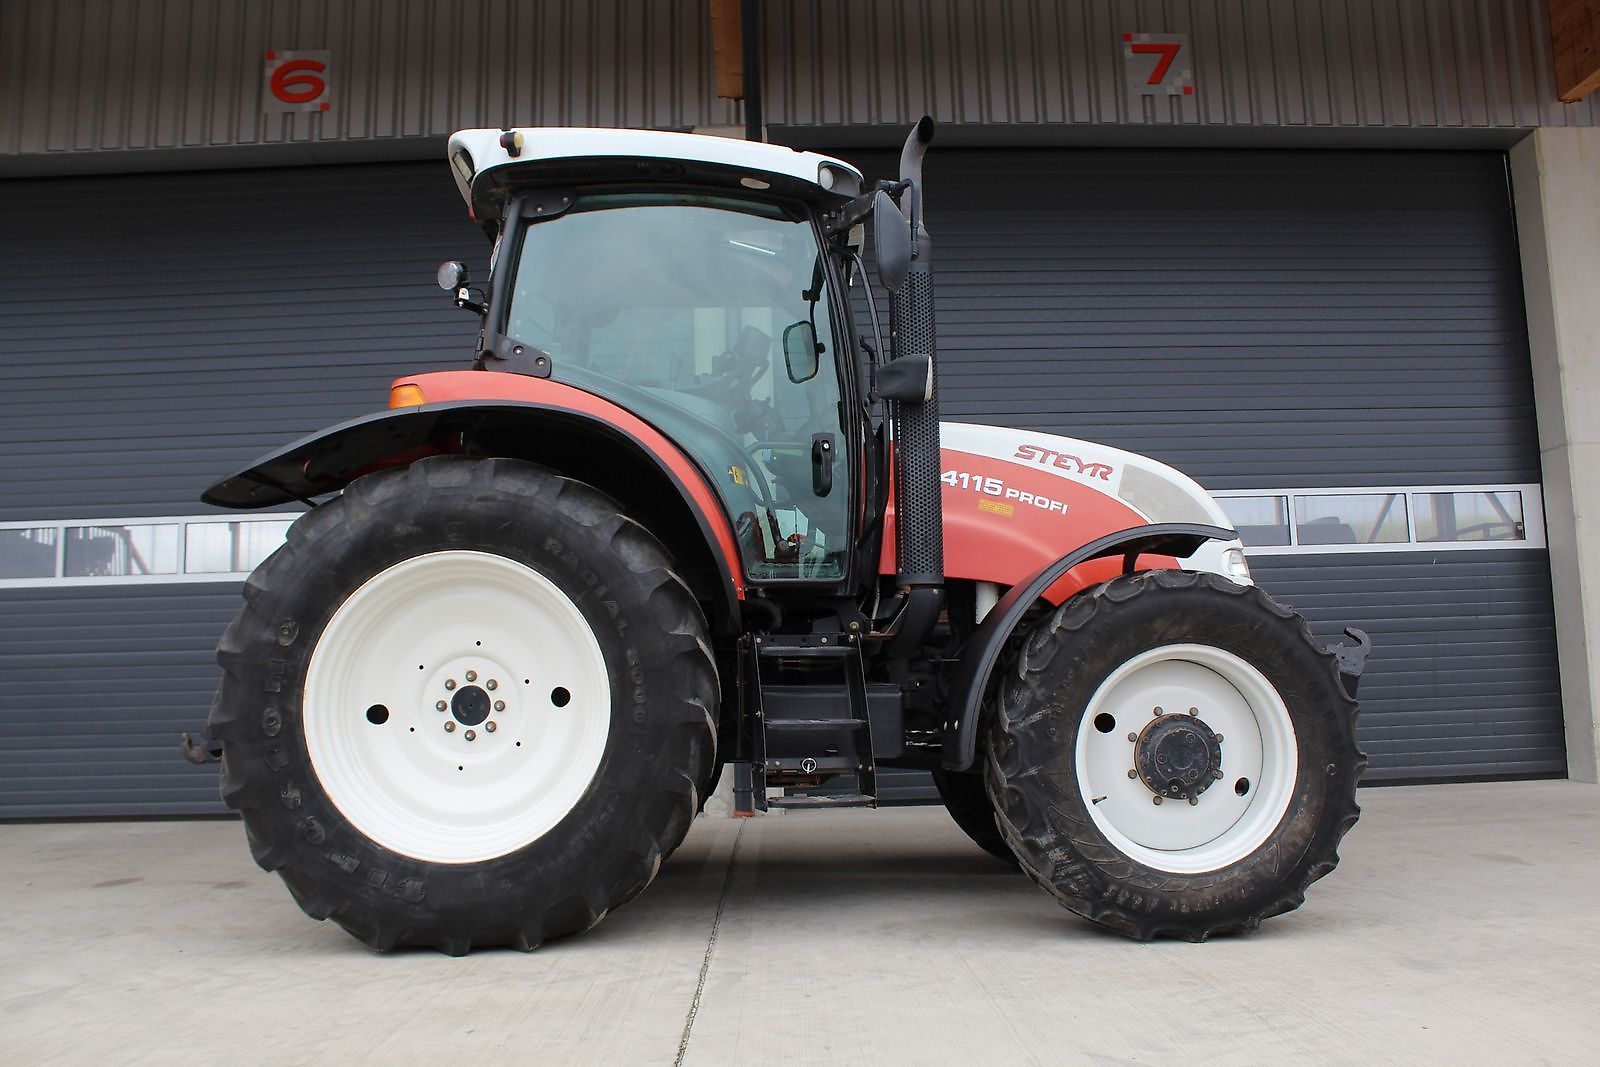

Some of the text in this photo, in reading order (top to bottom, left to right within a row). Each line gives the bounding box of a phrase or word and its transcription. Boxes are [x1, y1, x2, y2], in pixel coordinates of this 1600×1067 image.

[270, 59, 326, 104] 6
[1131, 43, 1181, 85] 7
[1014, 444, 1114, 481] STEYR
[940, 470, 1004, 497] 4115
[1005, 487, 1069, 516] PROFI
